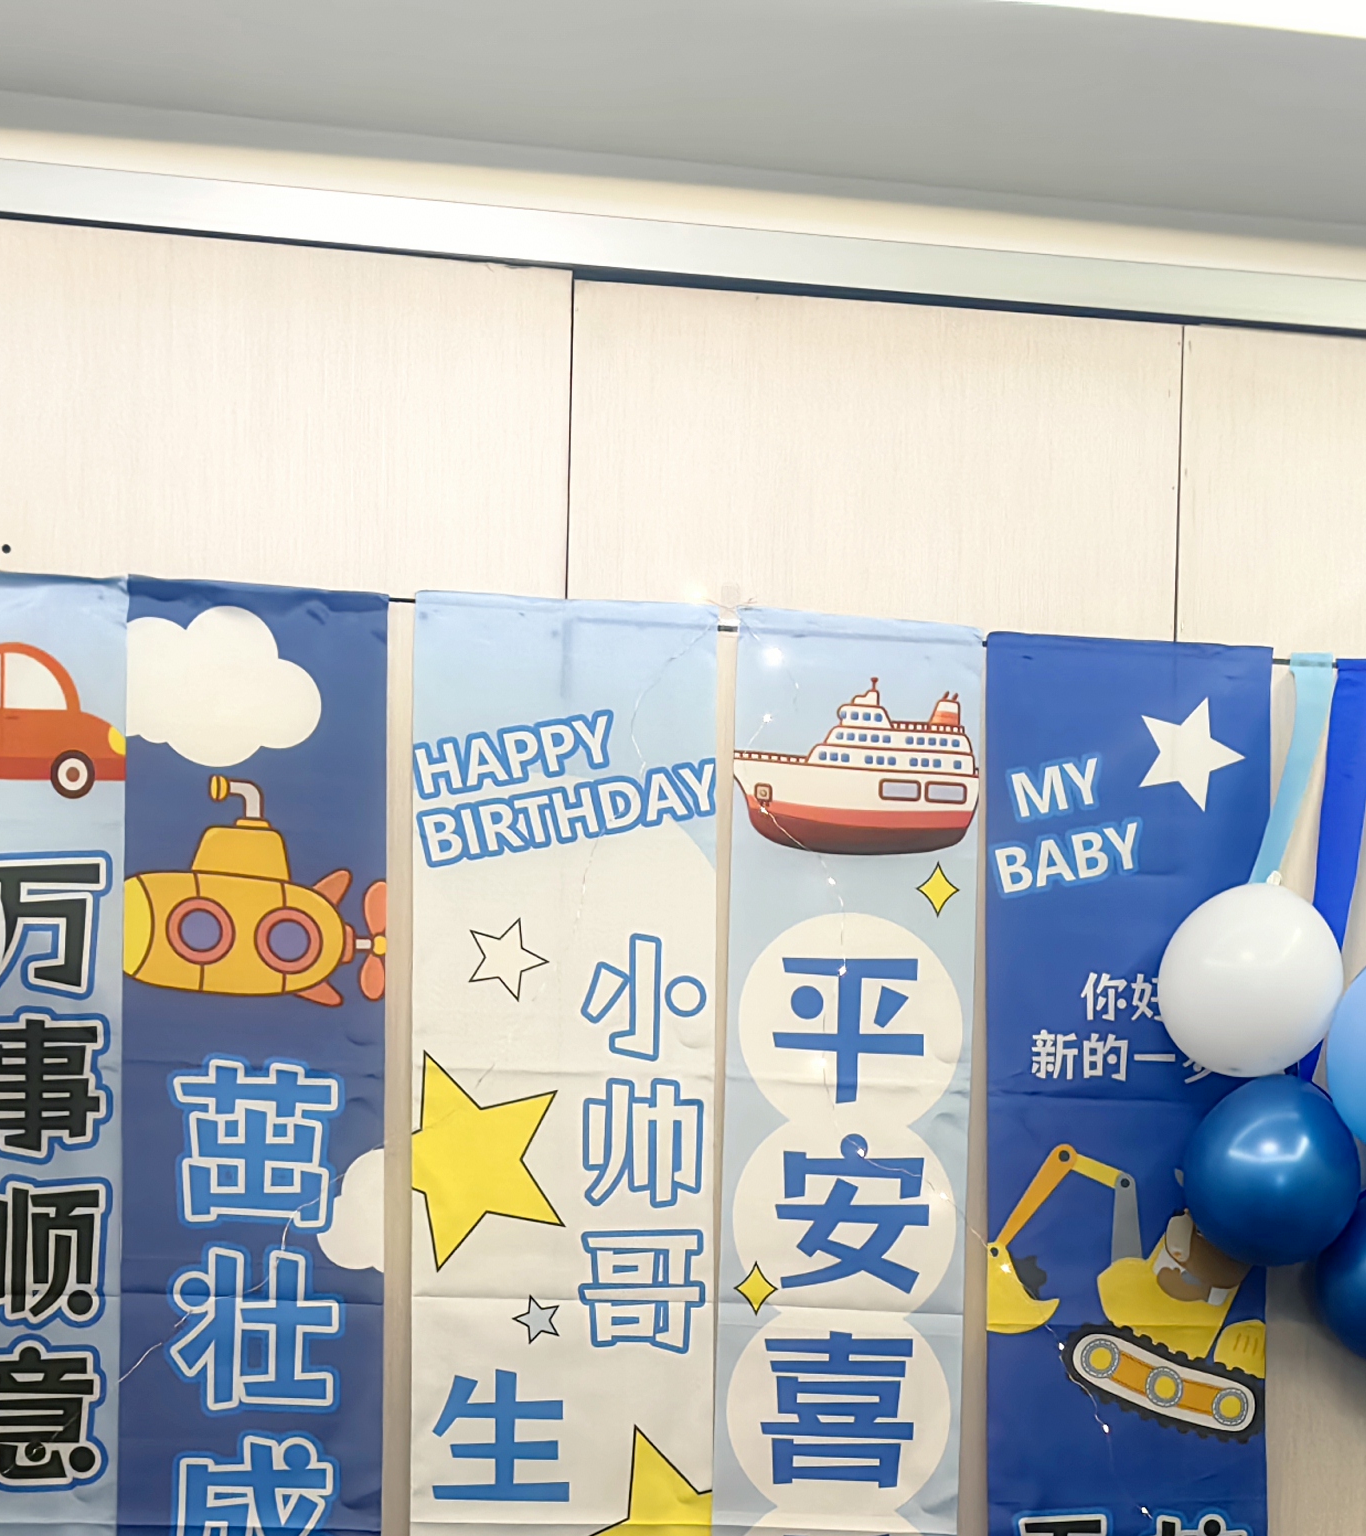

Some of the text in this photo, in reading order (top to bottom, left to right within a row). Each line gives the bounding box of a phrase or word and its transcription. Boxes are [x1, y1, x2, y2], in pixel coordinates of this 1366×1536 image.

[415, 711, 613, 798] HAPPY
[1009, 757, 1101, 820] MY
[418, 759, 715, 867] BIRTHDAY
[993, 822, 1141, 896] BABY
[1031, 1029, 1213, 1084] 新的一
[580, 933, 707, 1353] 小帅哥
